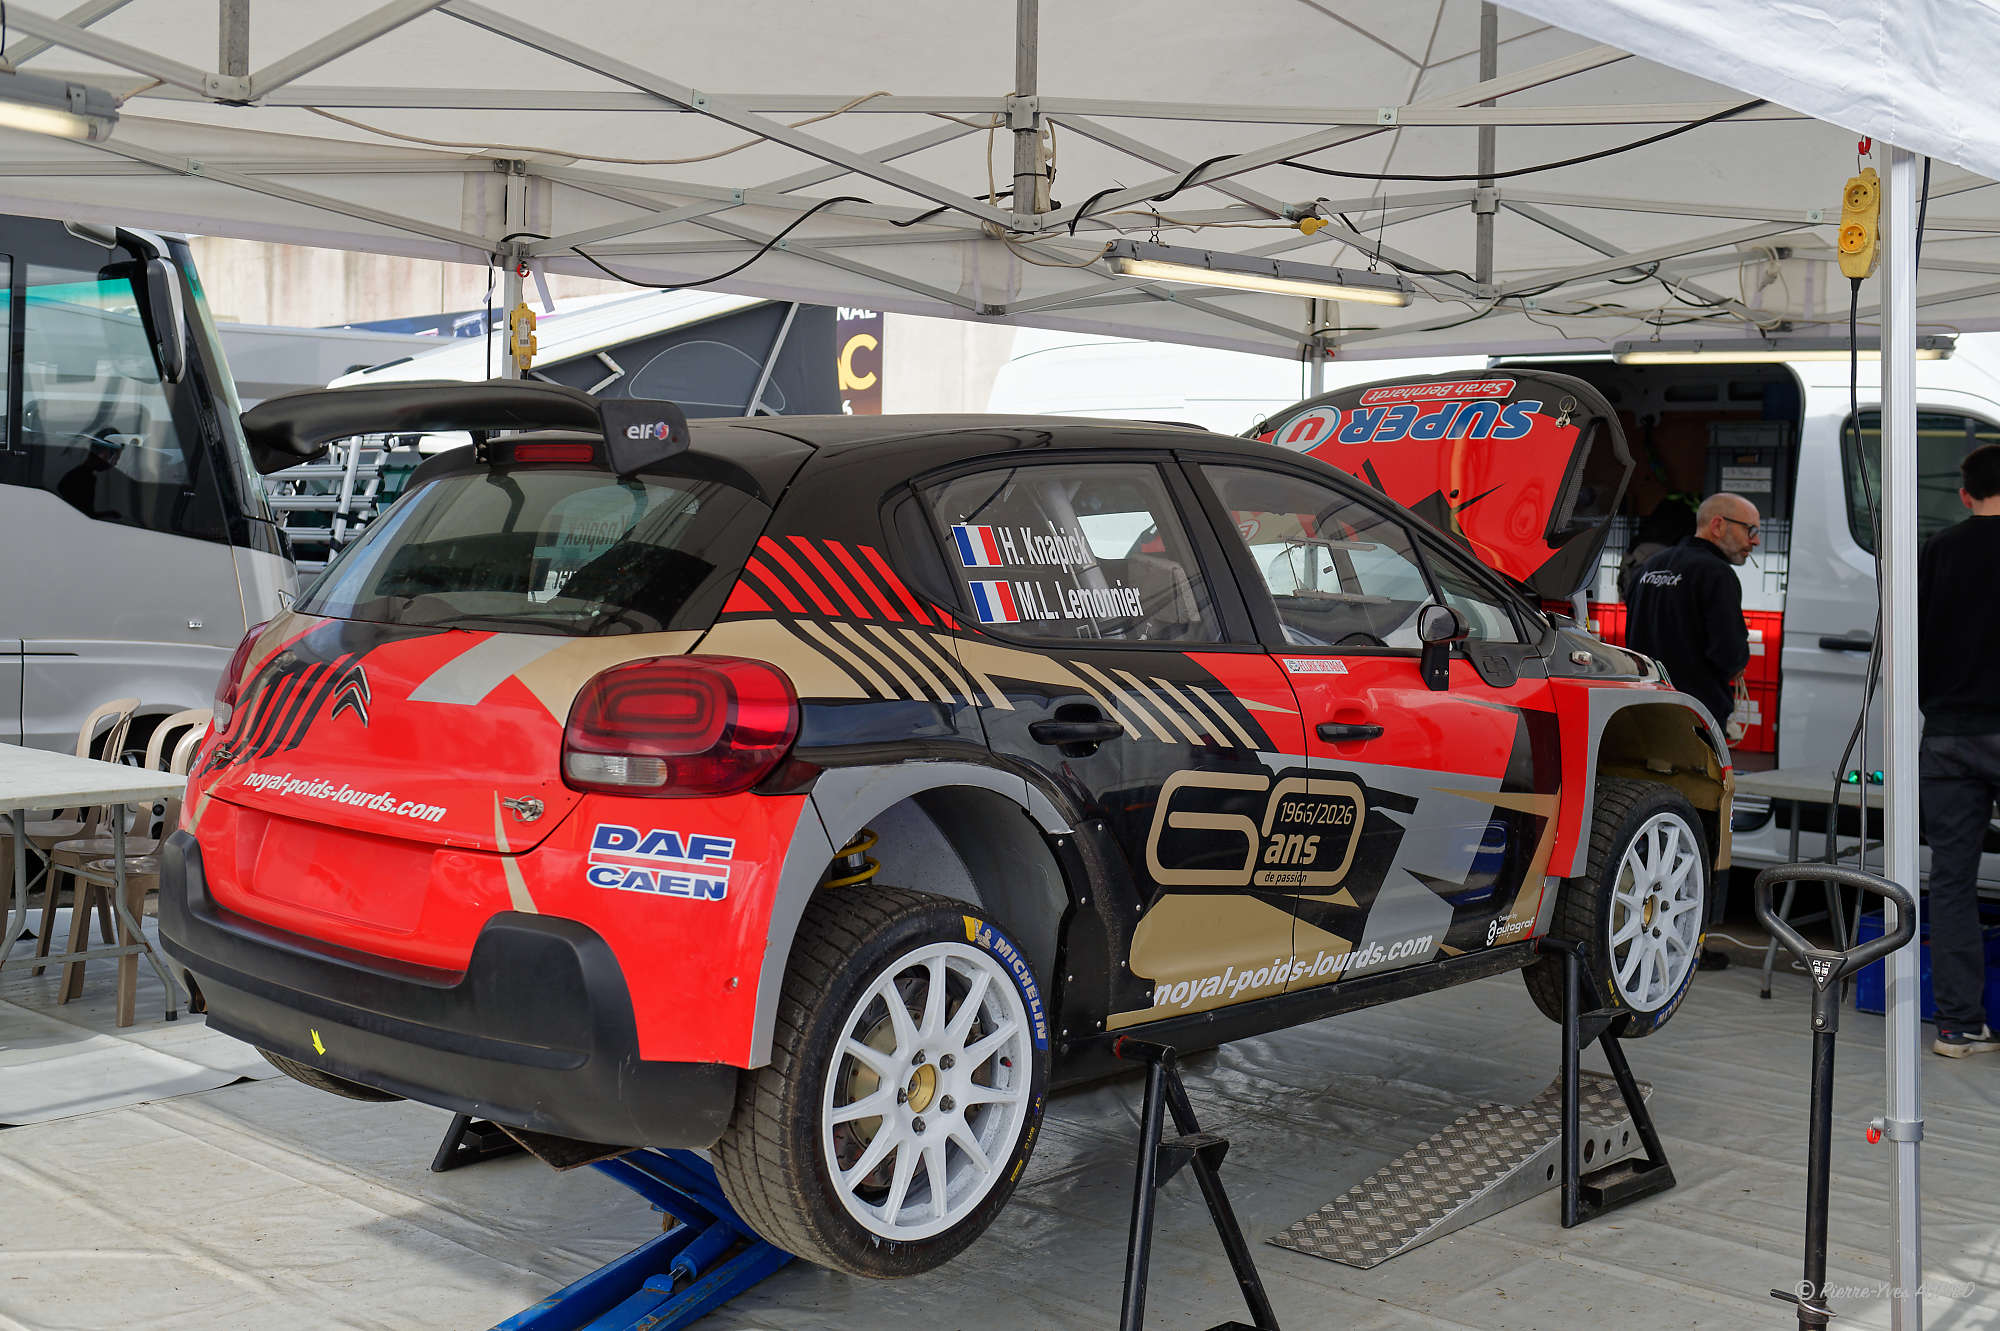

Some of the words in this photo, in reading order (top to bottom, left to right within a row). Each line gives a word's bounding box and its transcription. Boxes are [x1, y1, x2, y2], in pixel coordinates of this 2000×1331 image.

[1368, 385, 1450, 401] Bernhardt
[1455, 381, 1508, 396] Sarah
[627, 424, 653, 439] elf
[1338, 400, 1543, 444] SUPER
[997, 526, 1025, 564] H.
[1020, 527, 1093, 573] Knapick
[1015, 581, 1060, 620] M.L.
[1055, 579, 1144, 620] Lemonnier
[243, 771, 448, 822] noyal-poids-lourds.com
[1280, 801, 1355, 825] 1966/2026
[590, 824, 735, 862] DAF
[1263, 833, 1320, 865] ans
[588, 866, 728, 900] CAEN
[1264, 871, 1275, 882] de
[1276, 872, 1307, 885] passion
[993, 936, 1047, 1040] MICHELIN
[1153, 934, 1434, 1008] noyal-poids-lourds.com
